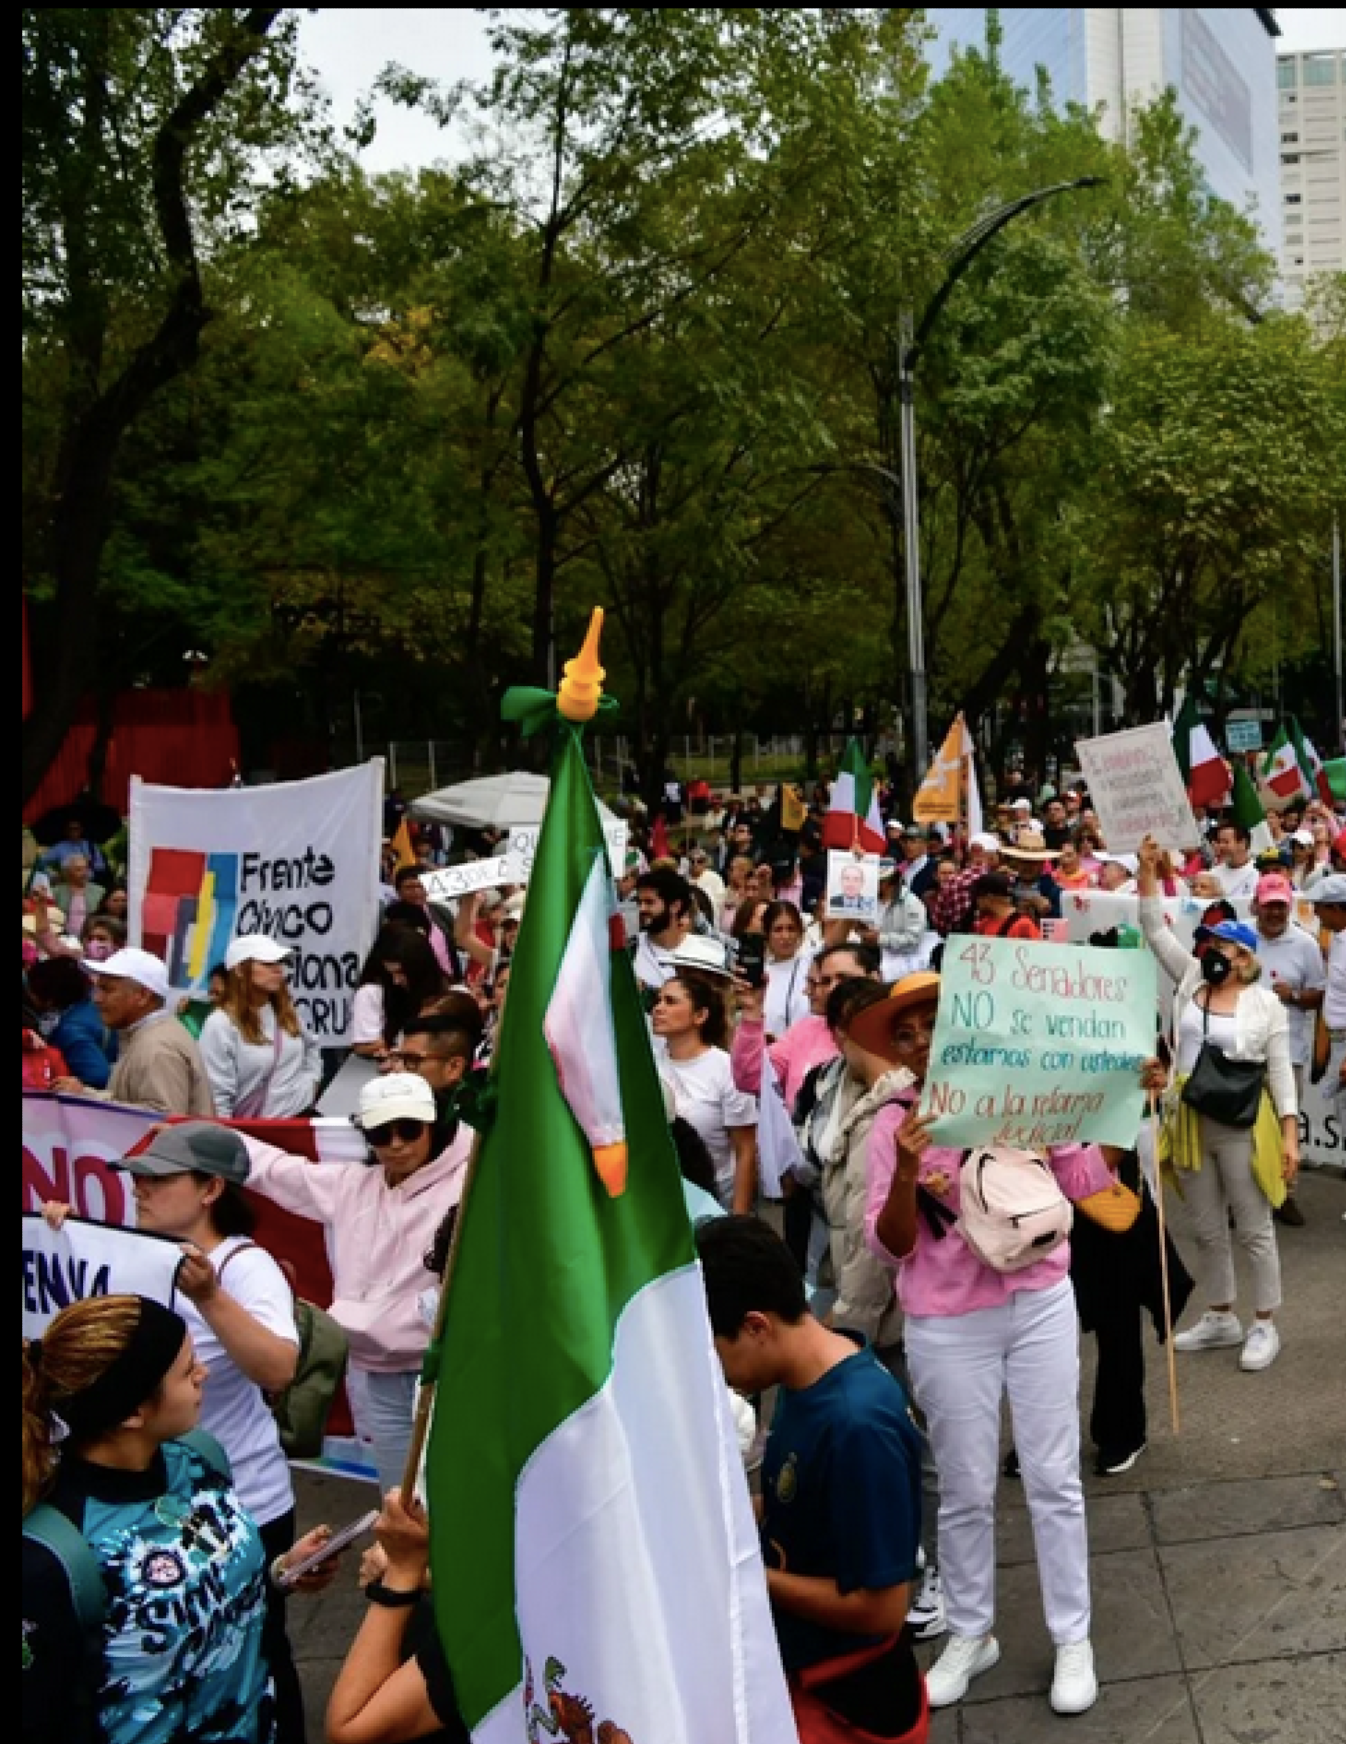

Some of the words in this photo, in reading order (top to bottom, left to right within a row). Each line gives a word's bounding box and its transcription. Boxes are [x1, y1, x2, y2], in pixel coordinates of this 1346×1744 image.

[240, 846, 335, 894] Frente
[959, 943, 994, 985] 43
[951, 991, 995, 1030] NO
[1045, 1010, 1126, 1039] vendan
[929, 1082, 966, 1117] NO
